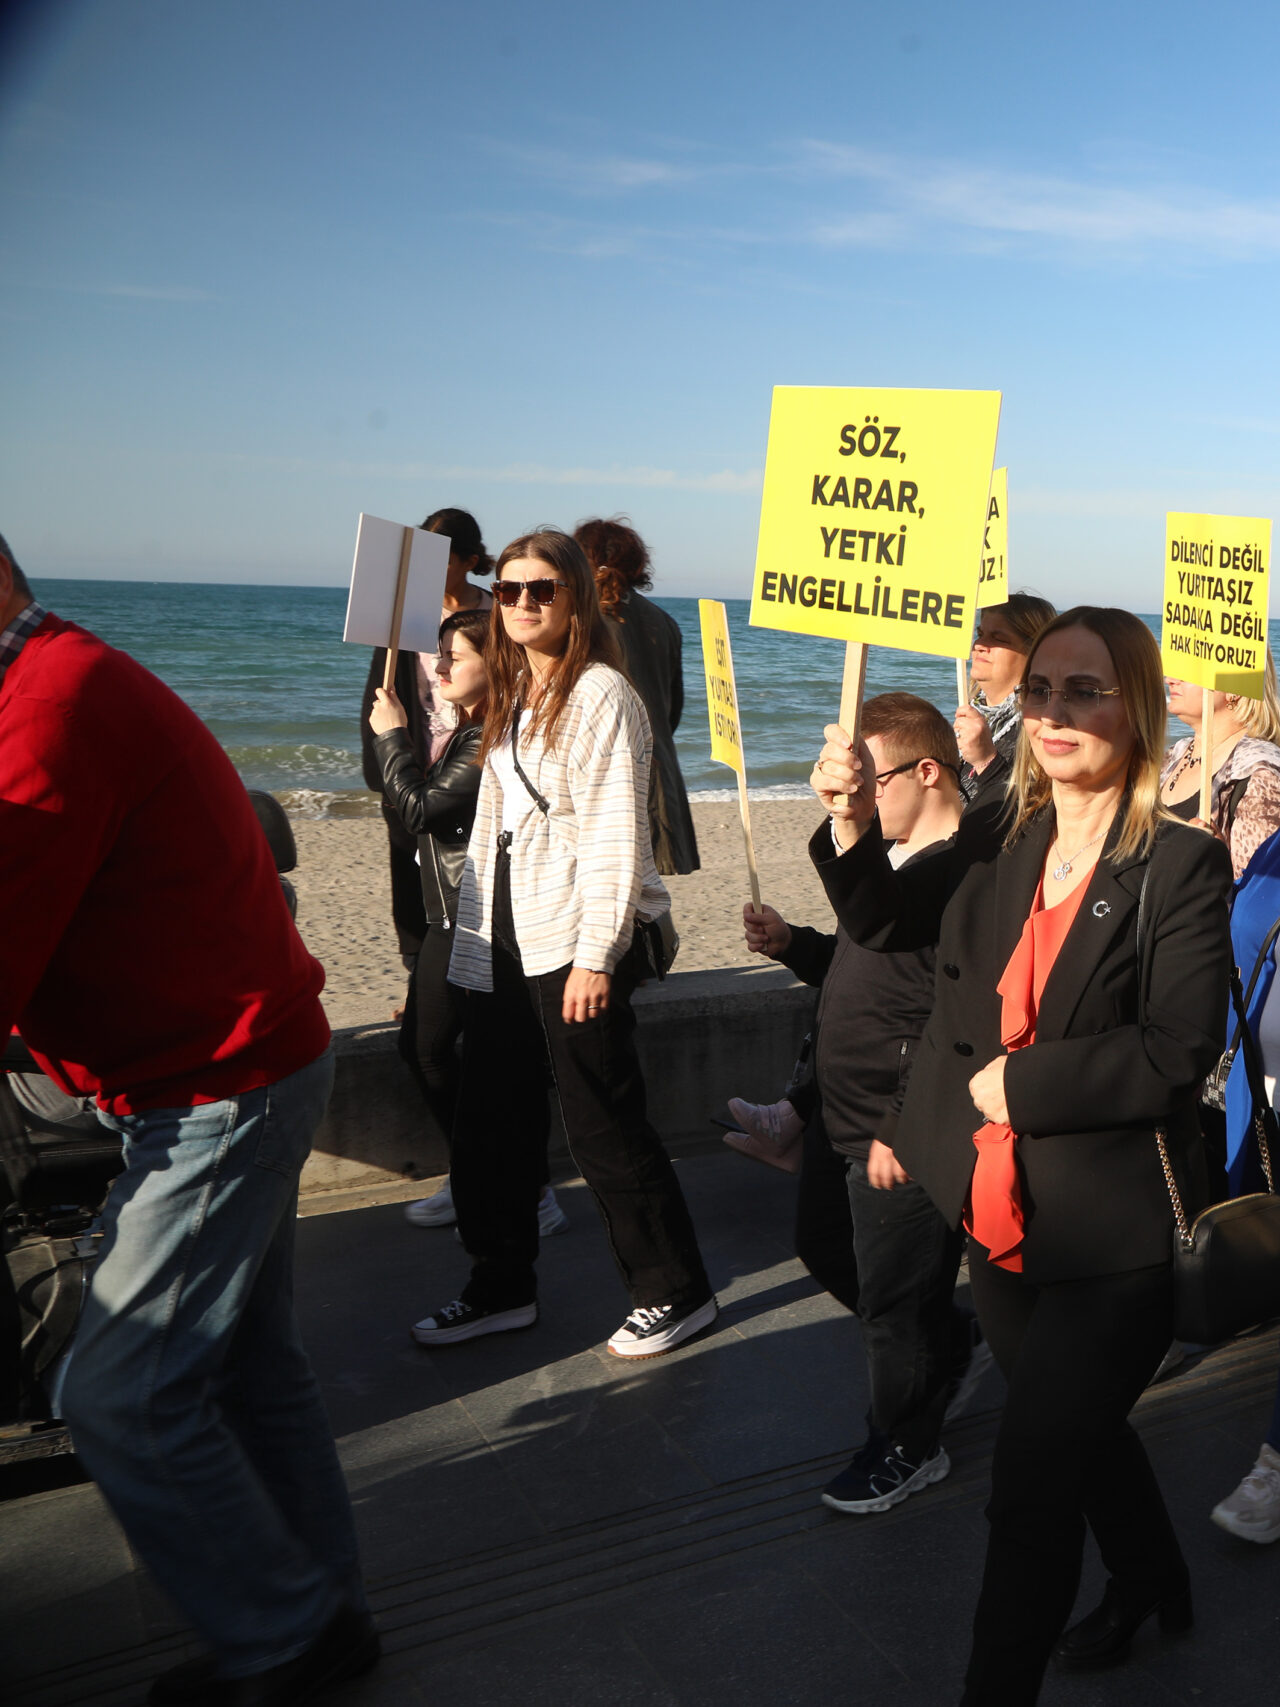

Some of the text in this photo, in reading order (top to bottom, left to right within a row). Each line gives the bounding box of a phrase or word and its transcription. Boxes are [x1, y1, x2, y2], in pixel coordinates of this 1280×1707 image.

[838, 415, 906, 464] SÖZ,
[811, 474, 925, 519] KARAR,
[820, 524, 907, 566] YETKİ
[1171, 535, 1265, 573] DİLENCİ DEĞİL
[760, 570, 966, 628] ENGELLİLERE
[1177, 571, 1254, 607] YURTTAŞIZ
[1166, 601, 1265, 642] SADAKA DEĞİL
[1170, 633, 1256, 670] HAK İSTİYORUZ!
